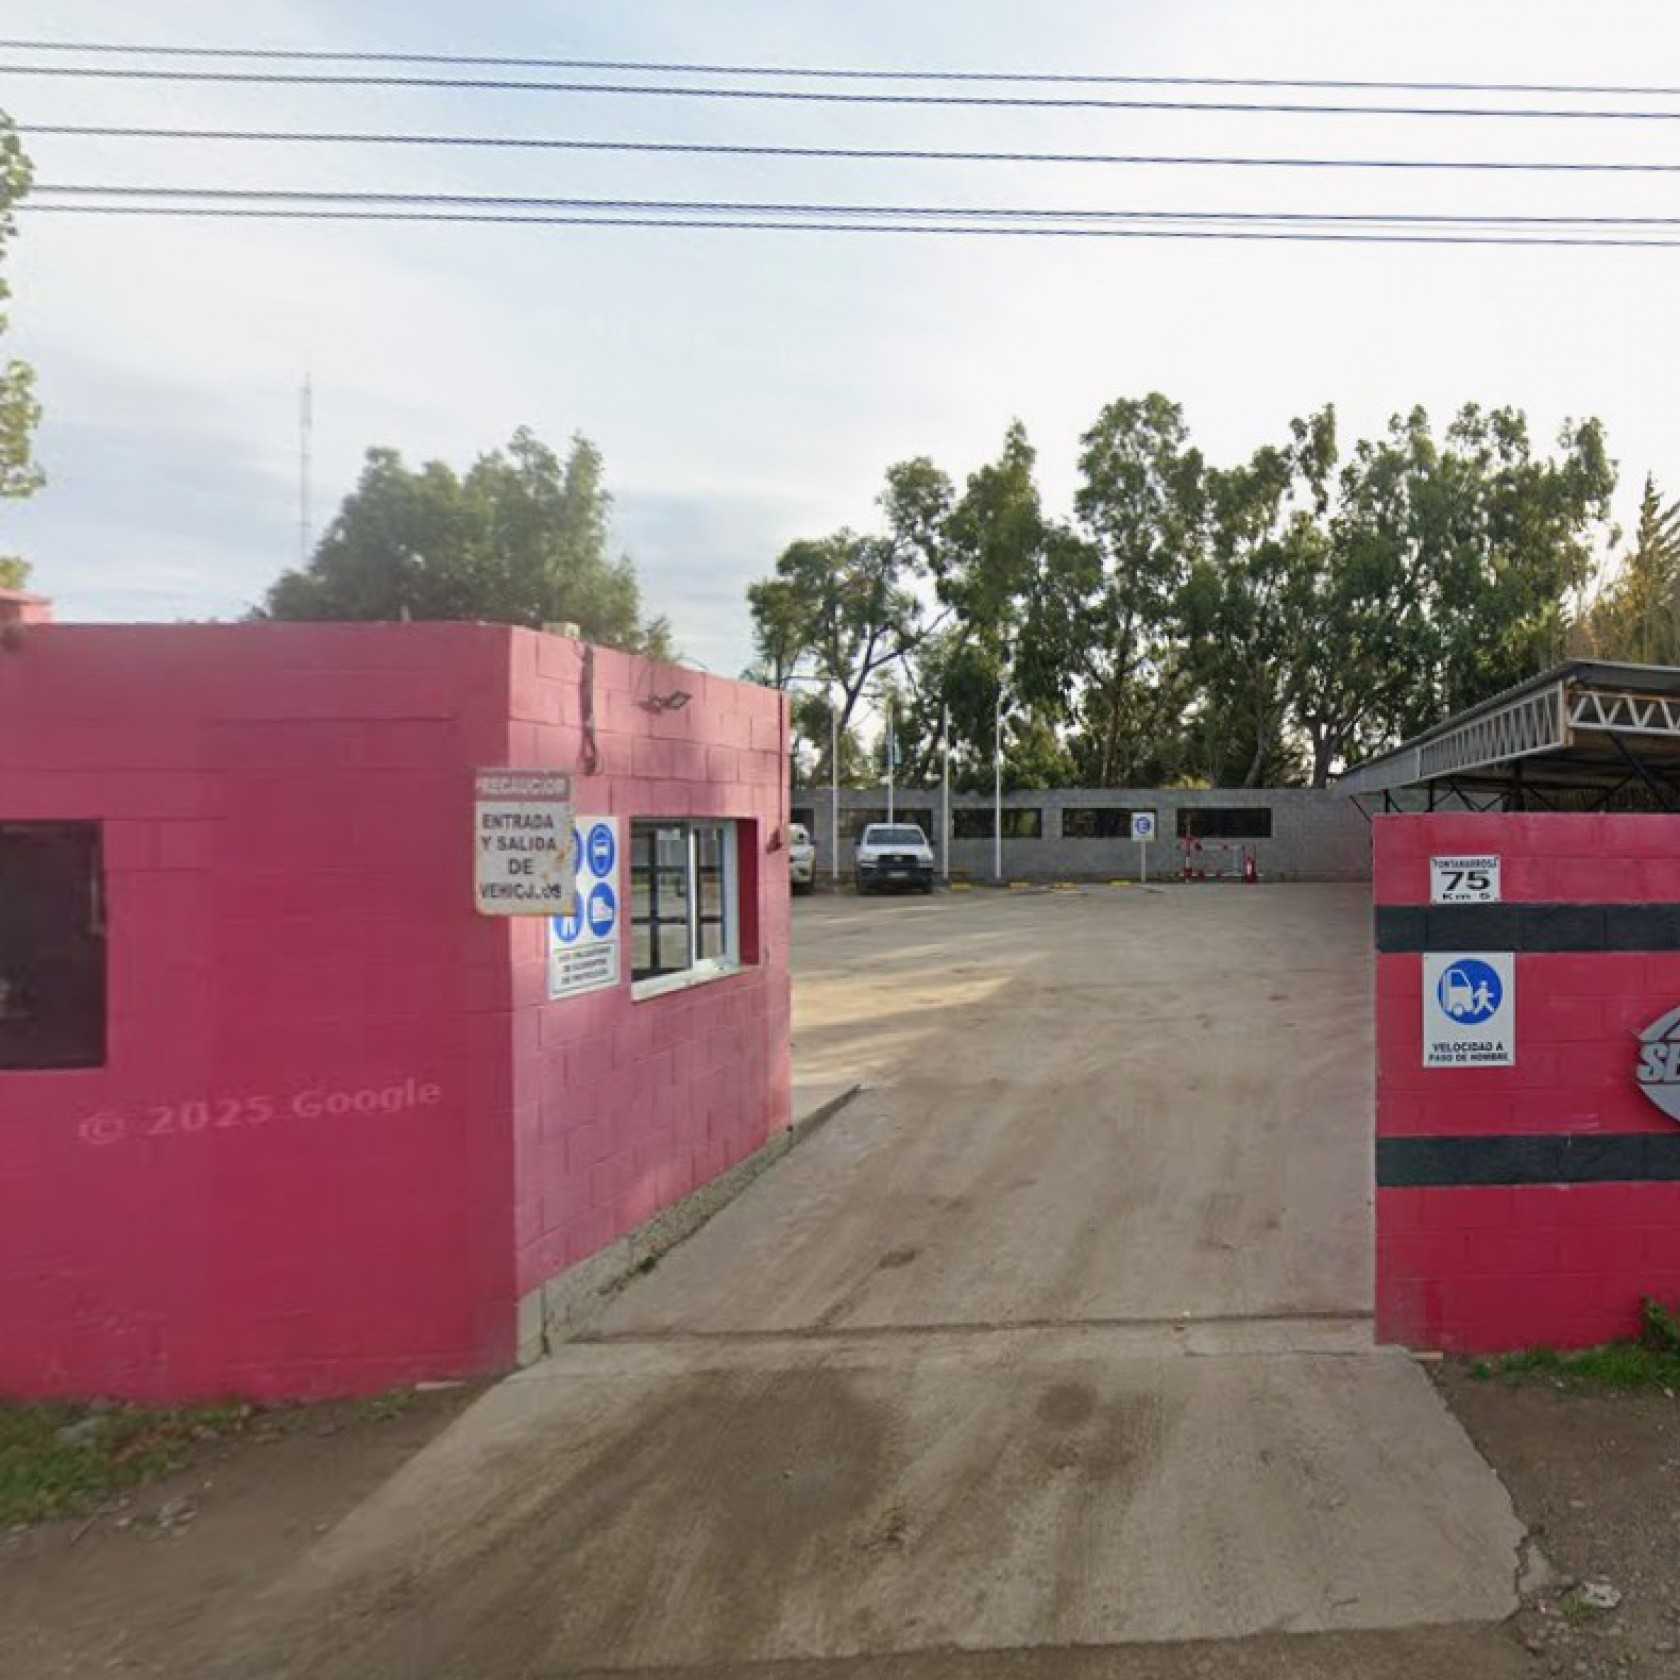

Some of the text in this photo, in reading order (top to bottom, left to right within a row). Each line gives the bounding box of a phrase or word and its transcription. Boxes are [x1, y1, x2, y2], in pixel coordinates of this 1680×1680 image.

[482, 813, 554, 829] ENTRADA
[481, 835, 556, 852] Y SALIDA
[508, 857, 534, 875] DE
[1441, 870, 1491, 891] 75
[1431, 1041, 1504, 1053] VELOCIDAD A
[1428, 1054, 1454, 1063] PASO
[1455, 1054, 1467, 1062] DE
